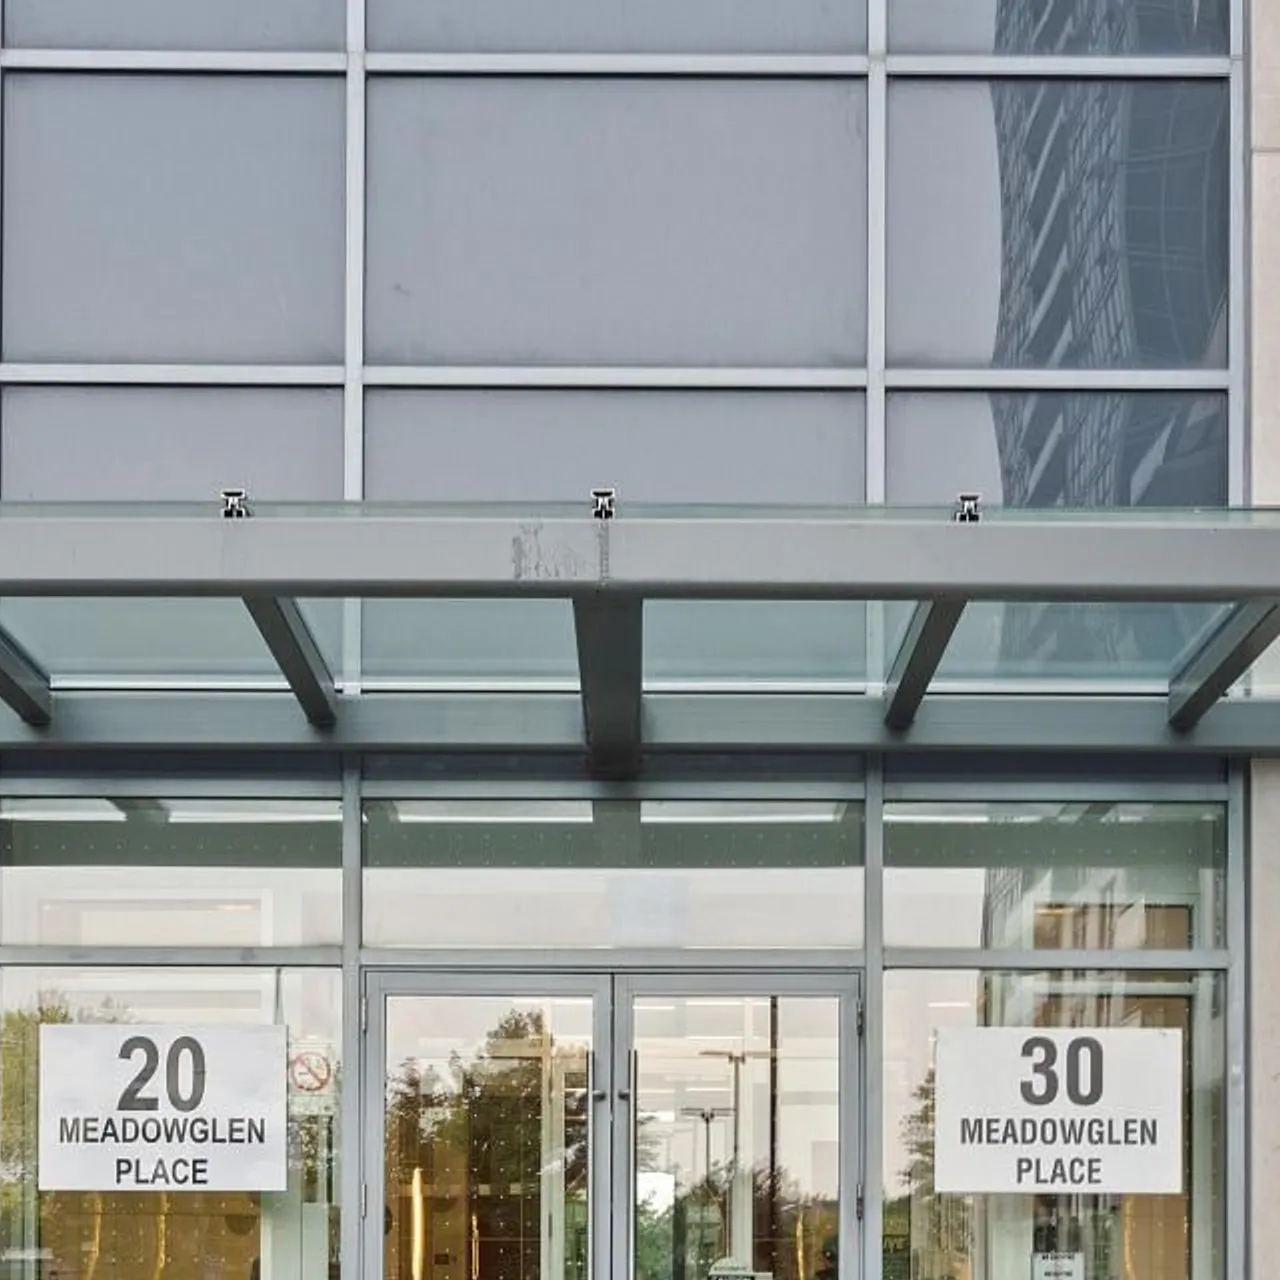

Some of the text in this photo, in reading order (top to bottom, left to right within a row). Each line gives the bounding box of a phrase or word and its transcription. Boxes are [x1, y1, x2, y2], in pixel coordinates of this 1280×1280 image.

[116, 1036, 206, 1112] 20
[1020, 1036, 1104, 1106] 30
[59, 1117, 265, 1144] MEADOWGLEN
[960, 1117, 1157, 1145] MEADOWGLEN
[116, 1158, 208, 1185] PLACE
[1016, 1157, 1102, 1184] PLACE
